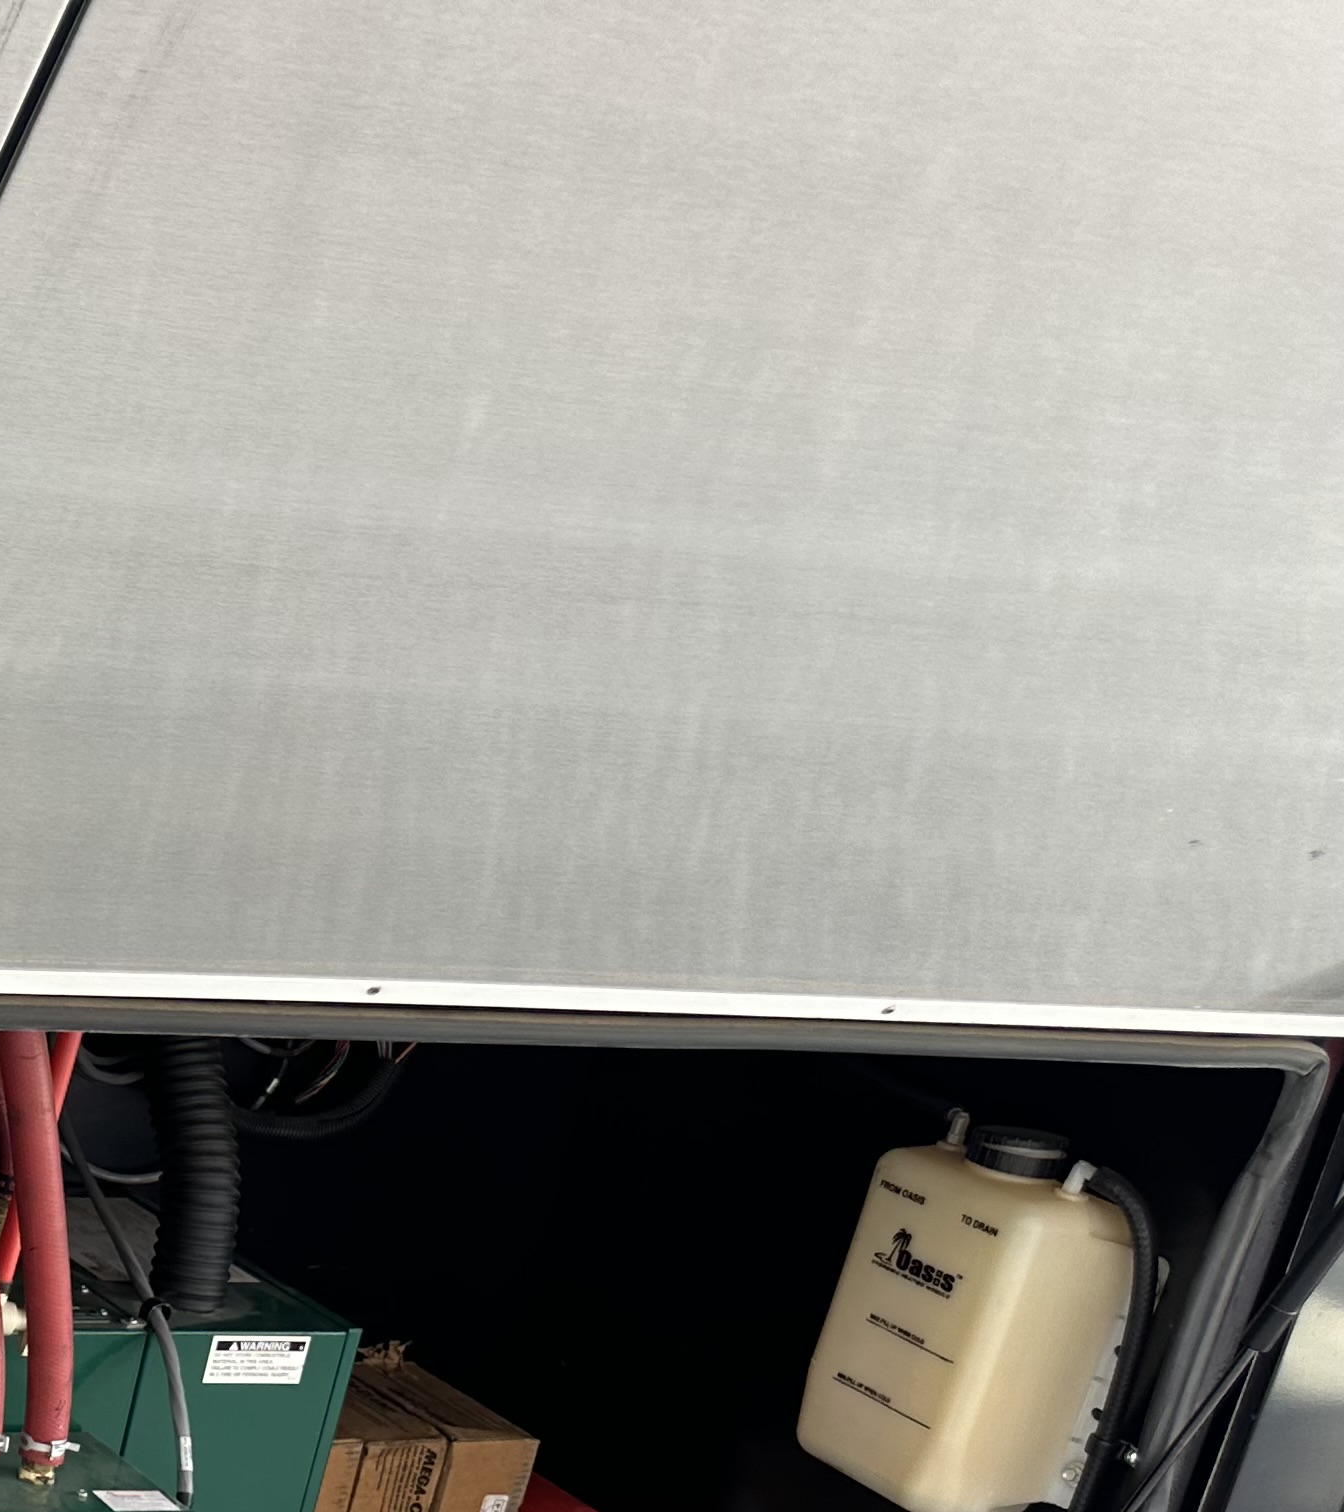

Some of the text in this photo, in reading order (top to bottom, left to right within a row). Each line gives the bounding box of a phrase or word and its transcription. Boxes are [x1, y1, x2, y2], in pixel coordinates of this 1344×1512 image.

[880, 1180, 926, 1206] FROM OASIS
[961, 1213, 999, 1237] TO DRAIN
[240, 1341, 291, 1351] WARNING
